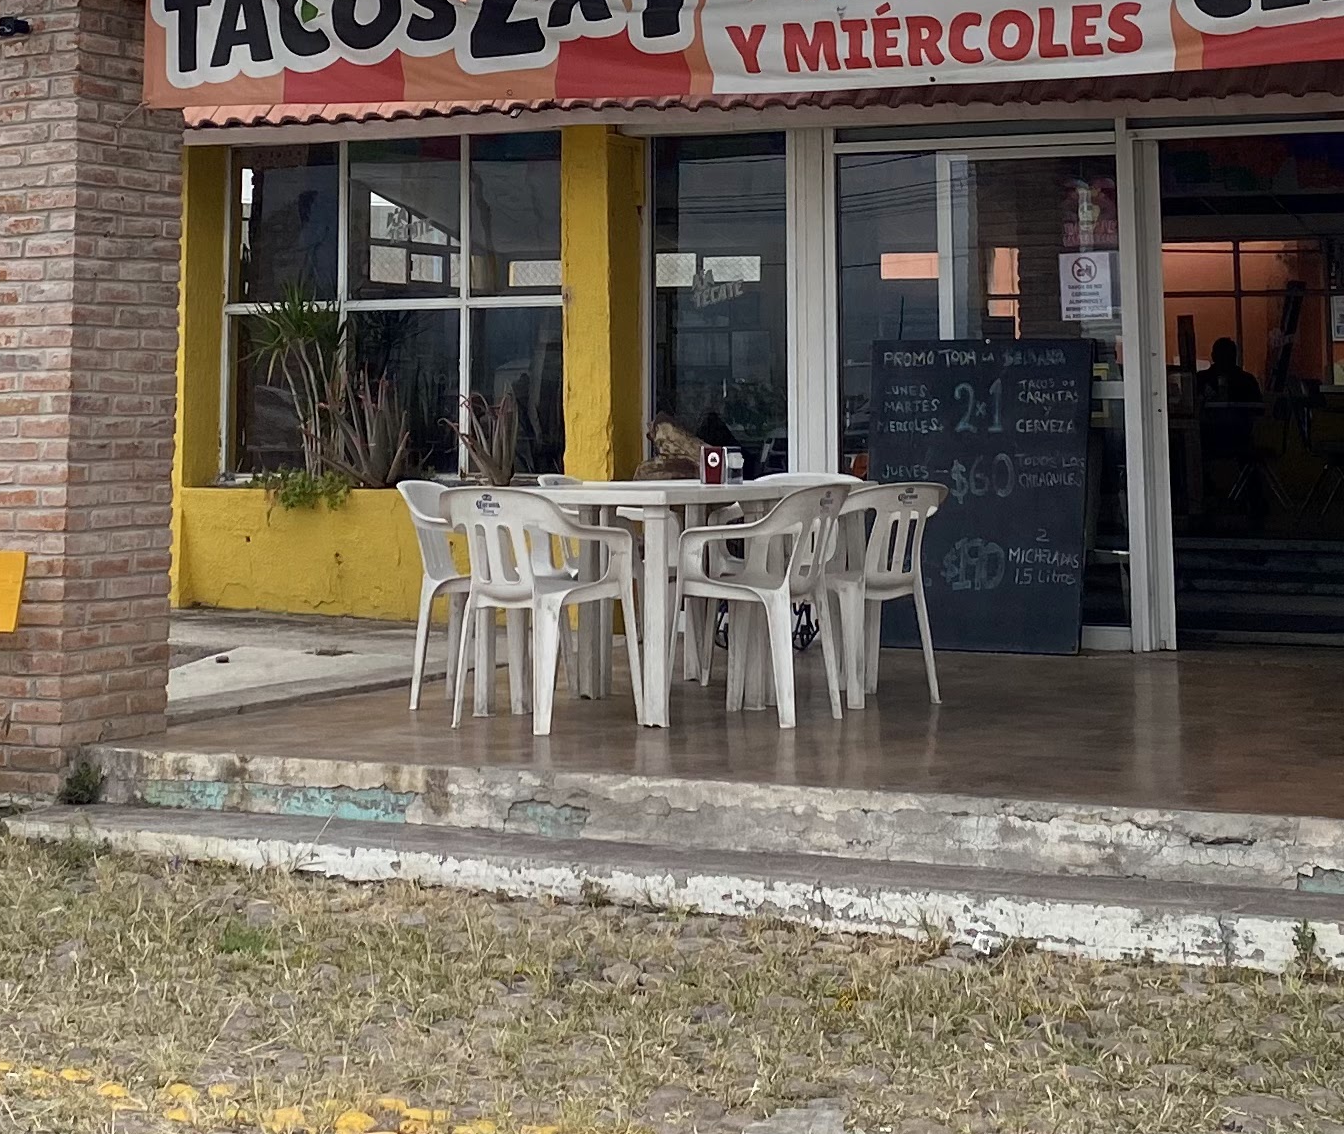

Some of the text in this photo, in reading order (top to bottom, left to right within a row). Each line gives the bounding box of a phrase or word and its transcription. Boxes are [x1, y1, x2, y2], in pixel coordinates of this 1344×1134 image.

[724, 1, 1144, 74] Y MIÉRCOLES
[883, 351, 935, 367] PROMO
[884, 399, 941, 414] MARTES
[1015, 419, 1076, 434] CERVEZA
[882, 463, 930, 479] JUEVES
